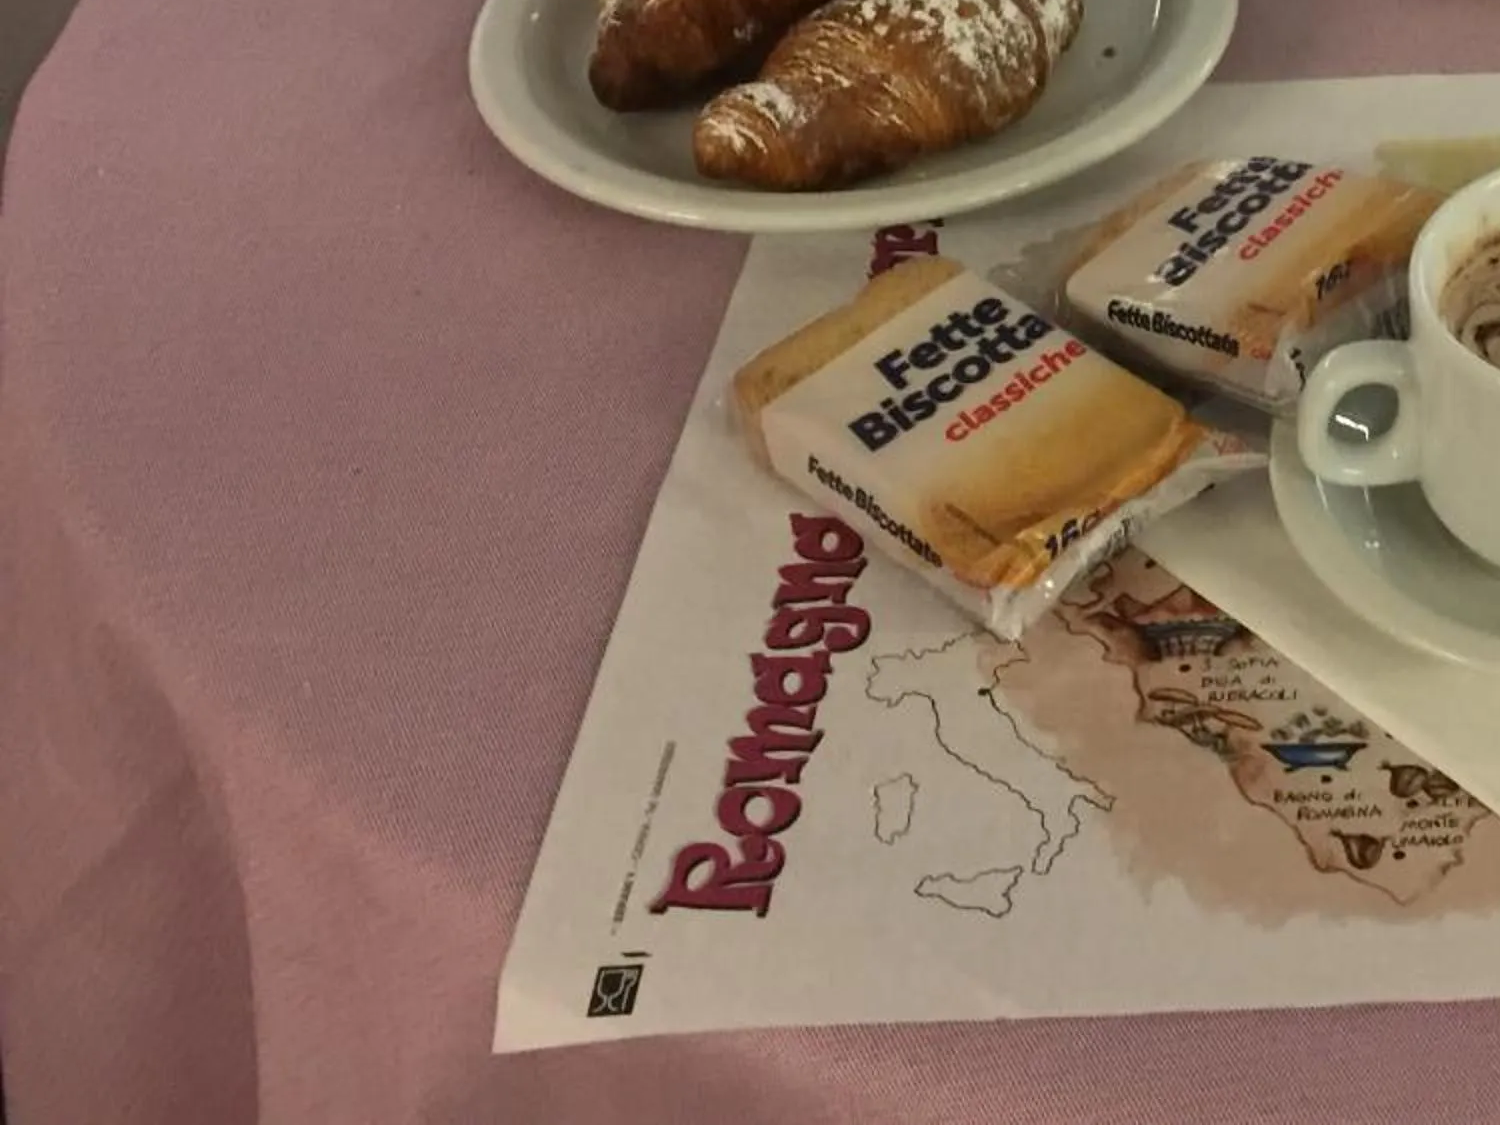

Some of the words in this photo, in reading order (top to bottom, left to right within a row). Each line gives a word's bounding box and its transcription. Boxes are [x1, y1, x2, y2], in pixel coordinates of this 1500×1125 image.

[1168, 156, 1278, 233] Fette
[874, 296, 1009, 390] Fette
[1107, 299, 1151, 332] Fette
[945, 338, 1087, 442] classiche
[808, 453, 854, 502] Fette
[648, 513, 872, 919] Romagna
